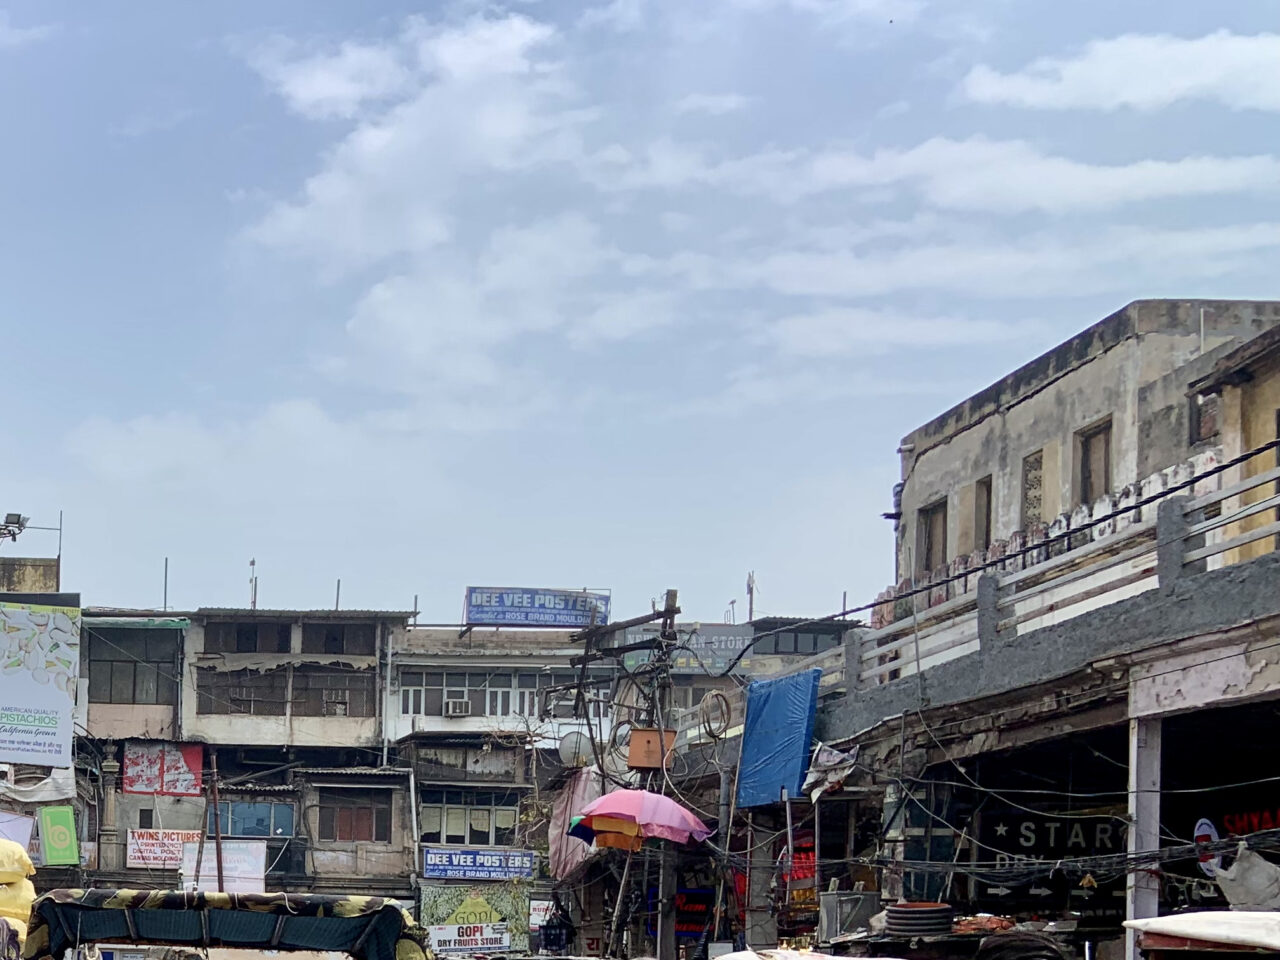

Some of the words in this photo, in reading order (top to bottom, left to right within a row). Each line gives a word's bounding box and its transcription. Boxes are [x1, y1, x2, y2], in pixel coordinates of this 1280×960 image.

[471, 592, 499, 606] DEE
[502, 593, 531, 607] VEE
[534, 594, 607, 612] POSTERS
[505, 611, 527, 620] ROSE
[527, 612, 554, 622] BRAND
[1, 706, 33, 714] AMERICAN
[0, 712, 58, 726] PISTACHIOS
[34, 728, 57, 738] Grown
[129, 830, 160, 841] TWINS
[161, 831, 202, 842] PICTURES
[1019, 821, 1113, 848] STAR
[132, 847, 158, 855] DIGITAL
[128, 854, 152, 862] CANVAS
[426, 853, 450, 866] DEE
[451, 854, 474, 867] VEE
[475, 855, 531, 869] POSTERS
[465, 870, 489, 878] BRAND
[454, 910, 494, 925] GOPI
[457, 925, 484, 938] GOPI
[437, 938, 452, 948] DRY
[453, 938, 479, 947] FRUITS
[479, 936, 504, 946] STORE
